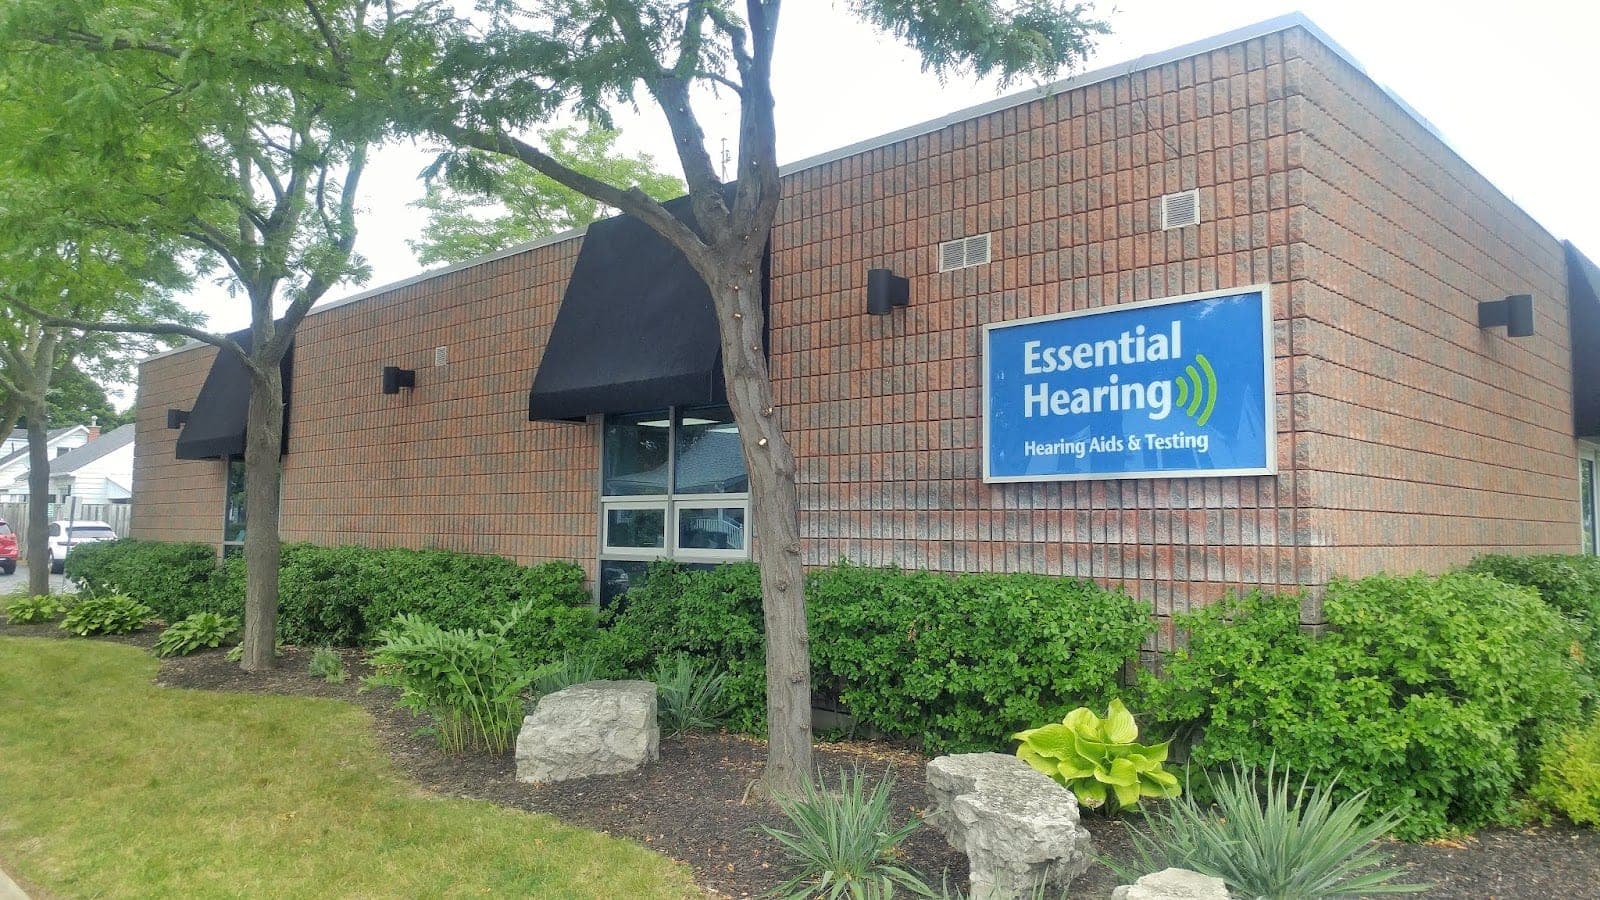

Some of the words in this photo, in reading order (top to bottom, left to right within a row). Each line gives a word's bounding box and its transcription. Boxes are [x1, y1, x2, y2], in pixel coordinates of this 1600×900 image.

[1024, 320, 1182, 375] Essential
[1024, 373, 1172, 420] Hearing
[1024, 438, 1086, 459] Hearing
[1089, 435, 1124, 453] Aids
[1128, 434, 1141, 451] &
[1145, 431, 1209, 453] Testing
